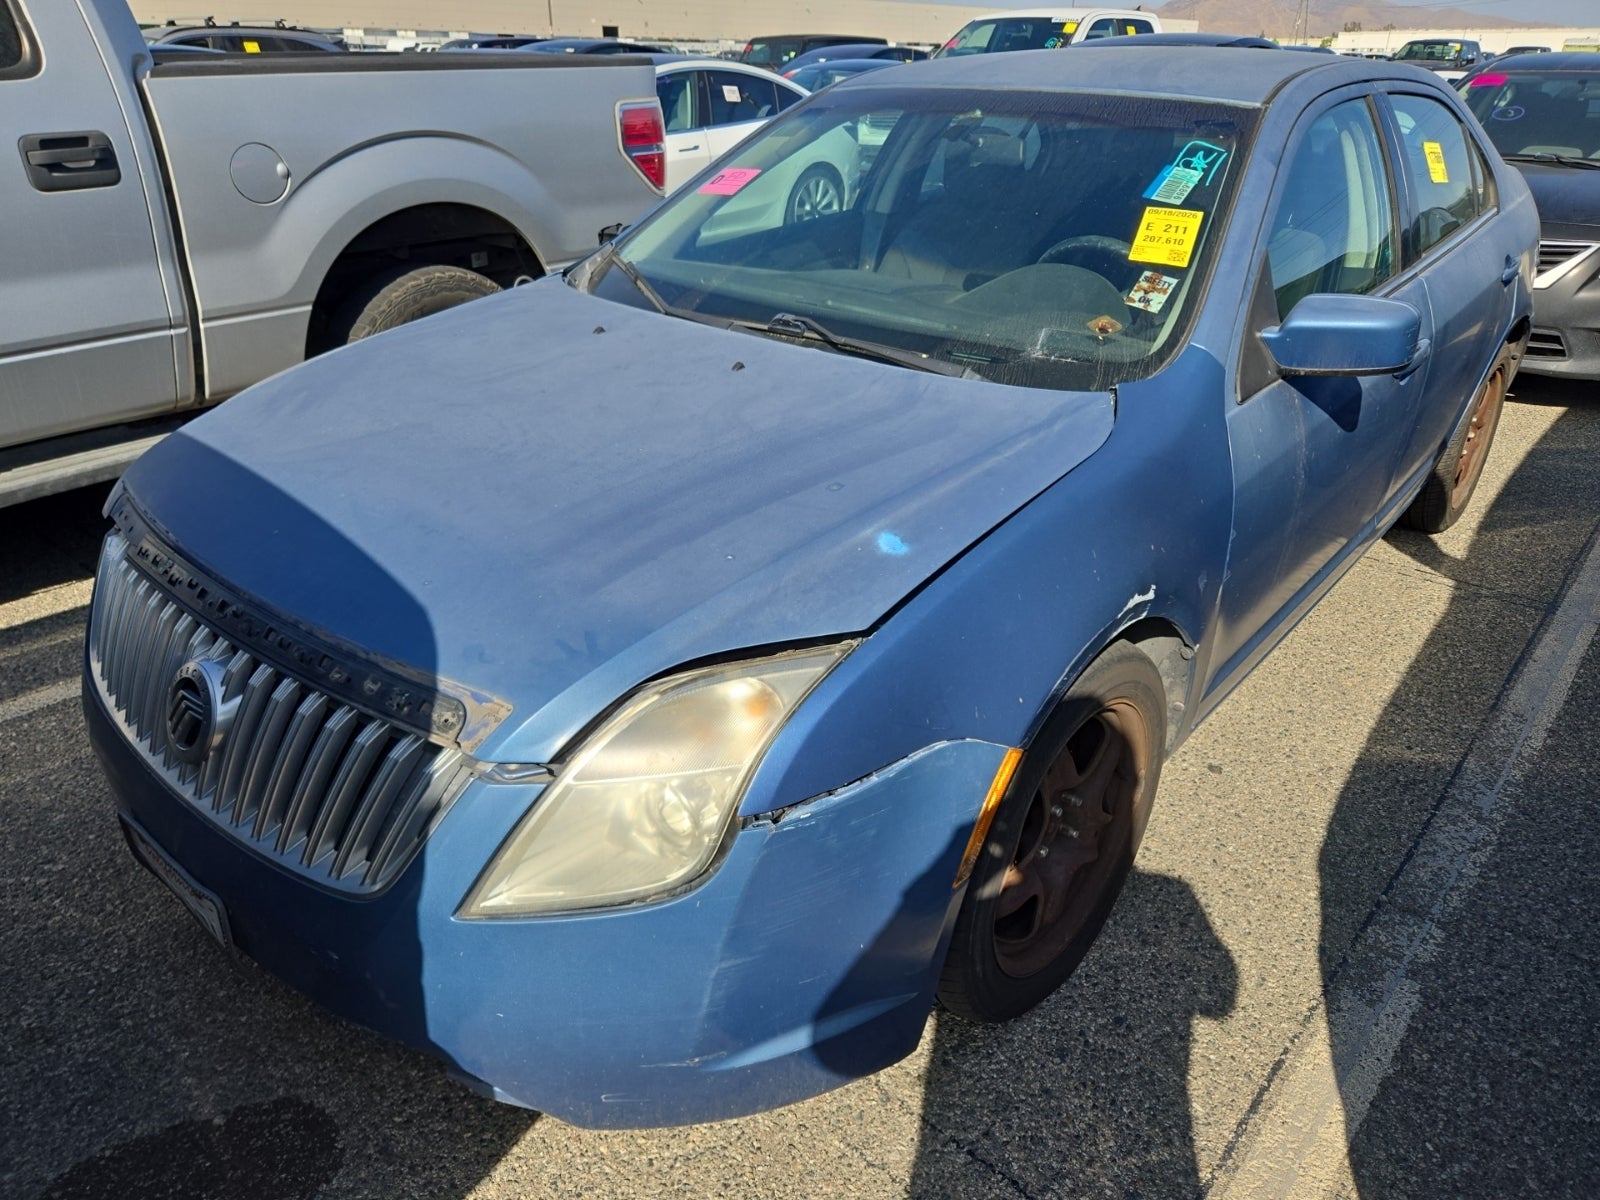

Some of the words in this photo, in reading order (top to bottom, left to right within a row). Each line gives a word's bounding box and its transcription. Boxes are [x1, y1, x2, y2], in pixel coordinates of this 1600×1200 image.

[1145, 222, 1155, 231] E
[1163, 223, 1188, 235] 211
[1138, 295, 1153, 306] OK
